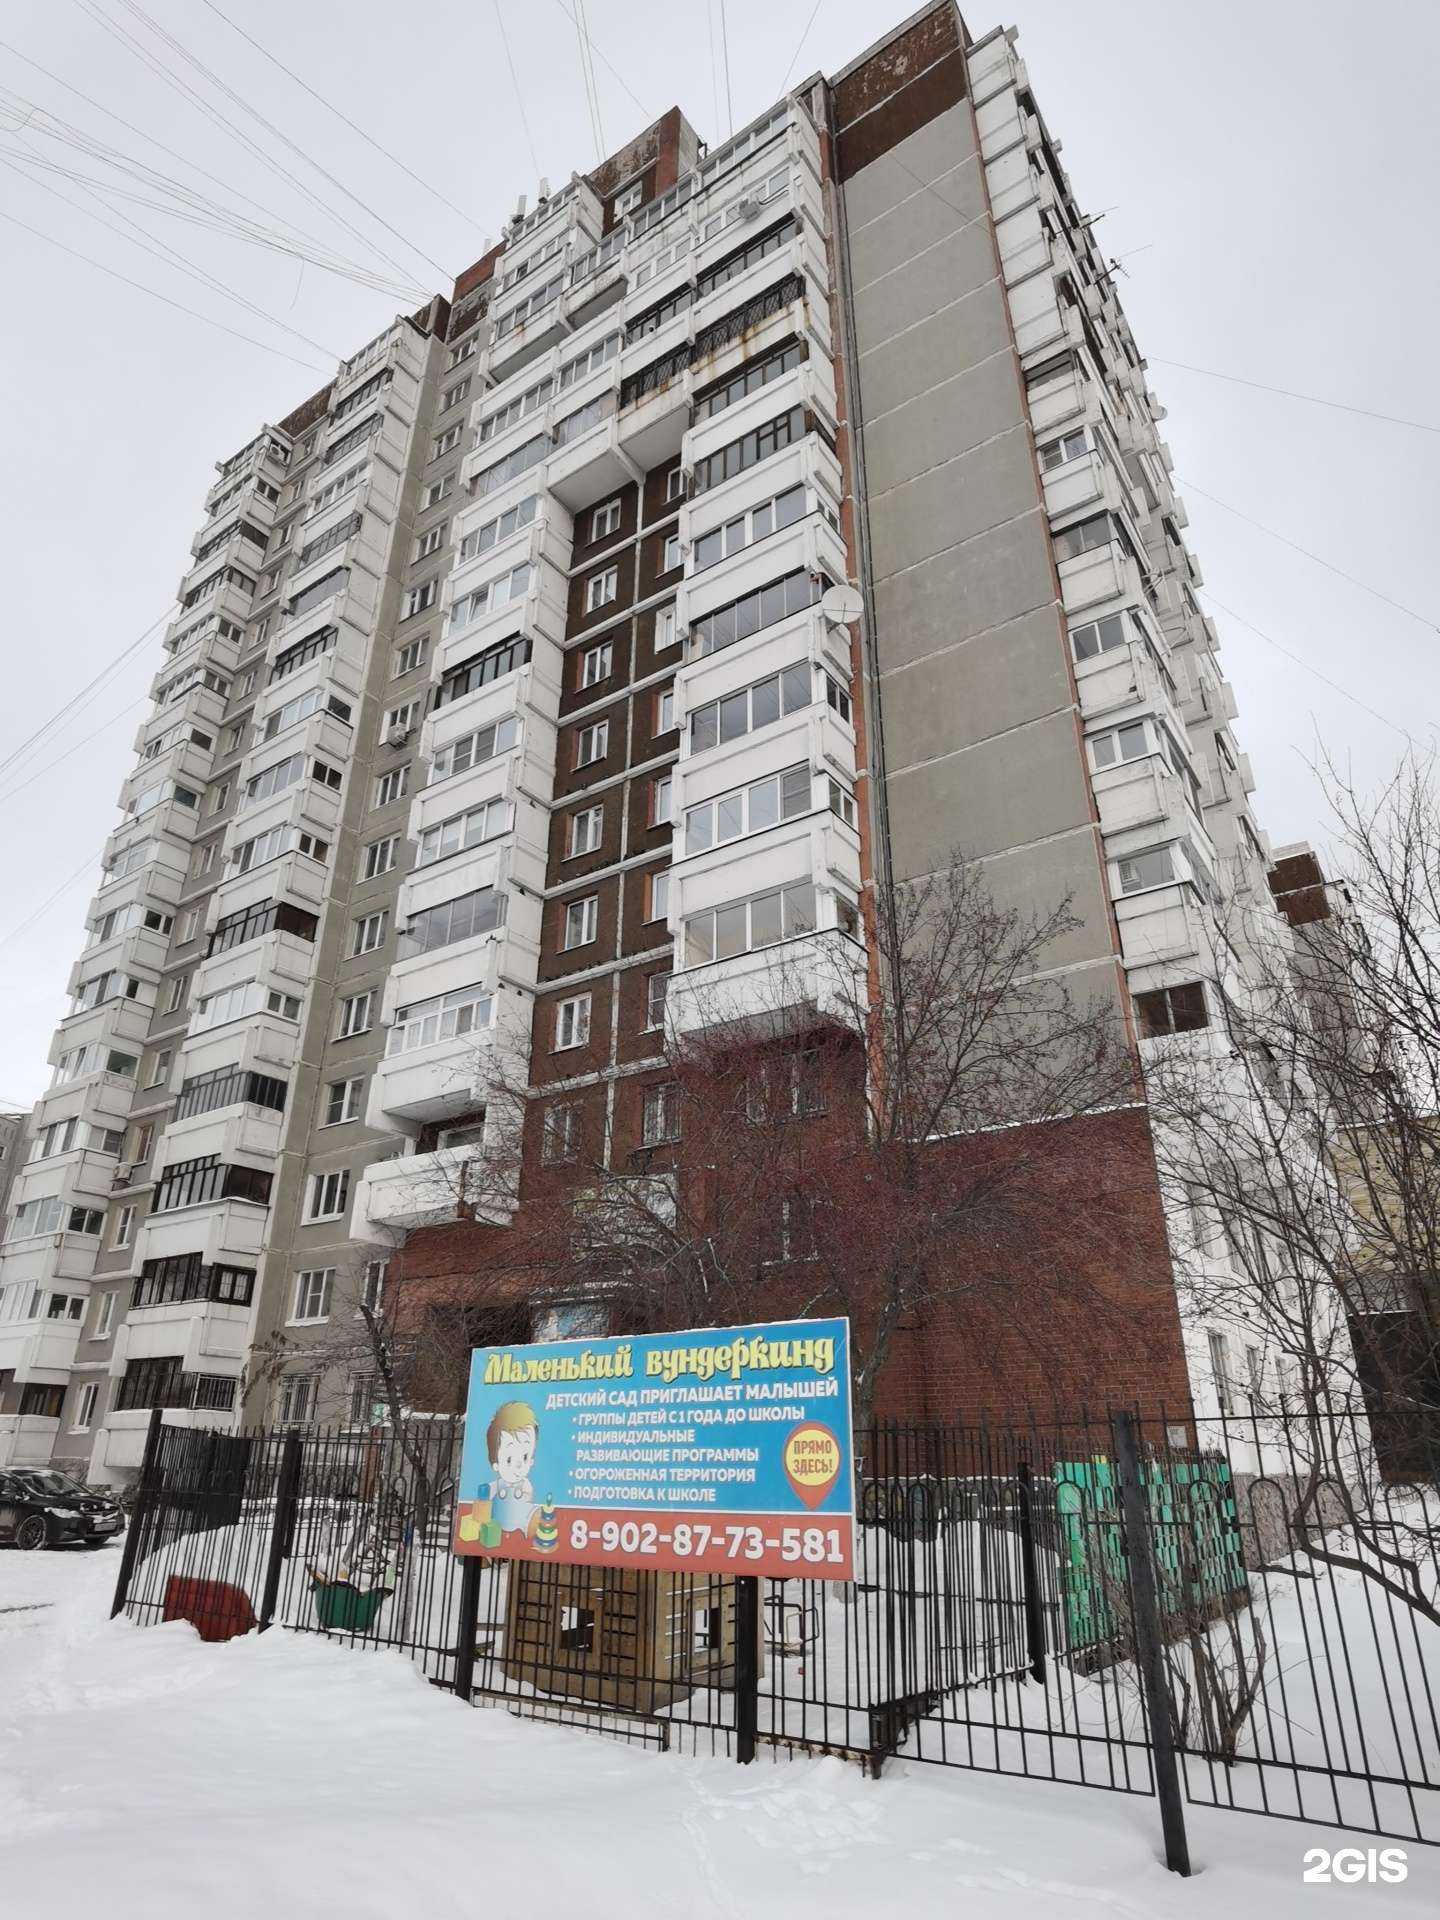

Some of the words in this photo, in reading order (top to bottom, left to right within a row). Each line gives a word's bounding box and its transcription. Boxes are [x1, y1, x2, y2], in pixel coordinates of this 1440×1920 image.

[484, 1344, 634, 1384] Маленький
[646, 1335, 836, 1383] вундеркинд
[545, 1389, 606, 1410] ДЕТСКИЙ
[608, 1389, 638, 1407] САД
[640, 1384, 744, 1404] ПРИГЛАШАЕТ
[745, 1377, 839, 1400] МАЛЫШЕЙ
[578, 1412, 626, 1426] ГРУППЫ
[627, 1408, 667, 1427] ДЕТЕЙ
[668, 1410, 679, 1425] С
[679, 1410, 685, 1425] 1
[687, 1409, 723, 1426] ГОДА
[724, 1407, 746, 1424] ДО
[748, 1406, 805, 1421] ШКОЛЫ
[577, 1429, 695, 1446] ИНДИВИДУАЛЬНЫЕ
[576, 1449, 670, 1464] РАЗВИВАЮЩИЕ
[672, 1447, 759, 1462] ПРОГРАММЫ
[793, 1439, 833, 1455] ПРЯМО
[793, 1457, 833, 1475] ЗДЕСЬ!
[574, 1467, 668, 1482] ОГОРОЖЕННАЯ
[669, 1467, 756, 1483] ТЕРРИТОРИЯ
[573, 1486, 655, 1501] ПОДГОТОВКА
[657, 1487, 665, 1501] К
[667, 1487, 717, 1502] ШКОЛЕ
[570, 1518, 845, 1564] 8-902-87-73-581
